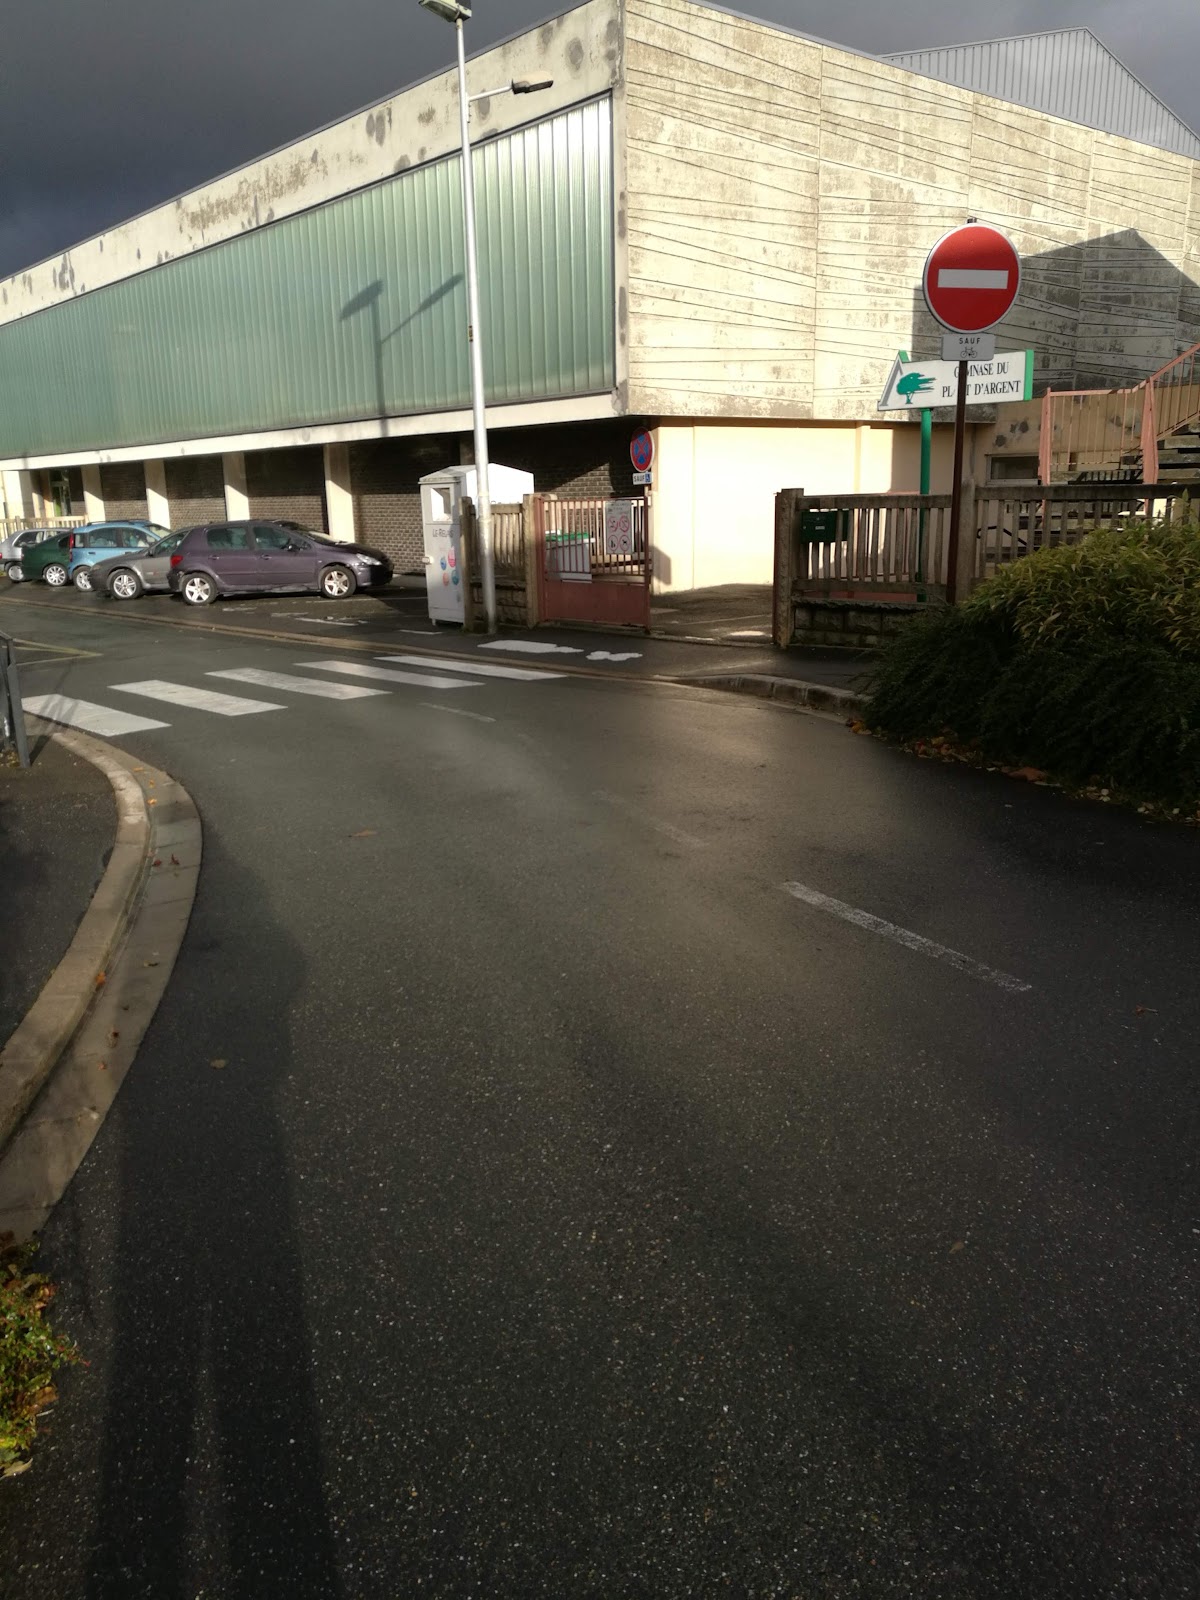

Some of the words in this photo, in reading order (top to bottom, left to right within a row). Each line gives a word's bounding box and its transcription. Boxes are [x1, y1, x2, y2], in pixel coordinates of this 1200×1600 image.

[954, 363, 993, 378] GMNASE
[997, 362, 1009, 374] DU
[974, 380, 1021, 395] D'ARGENT
